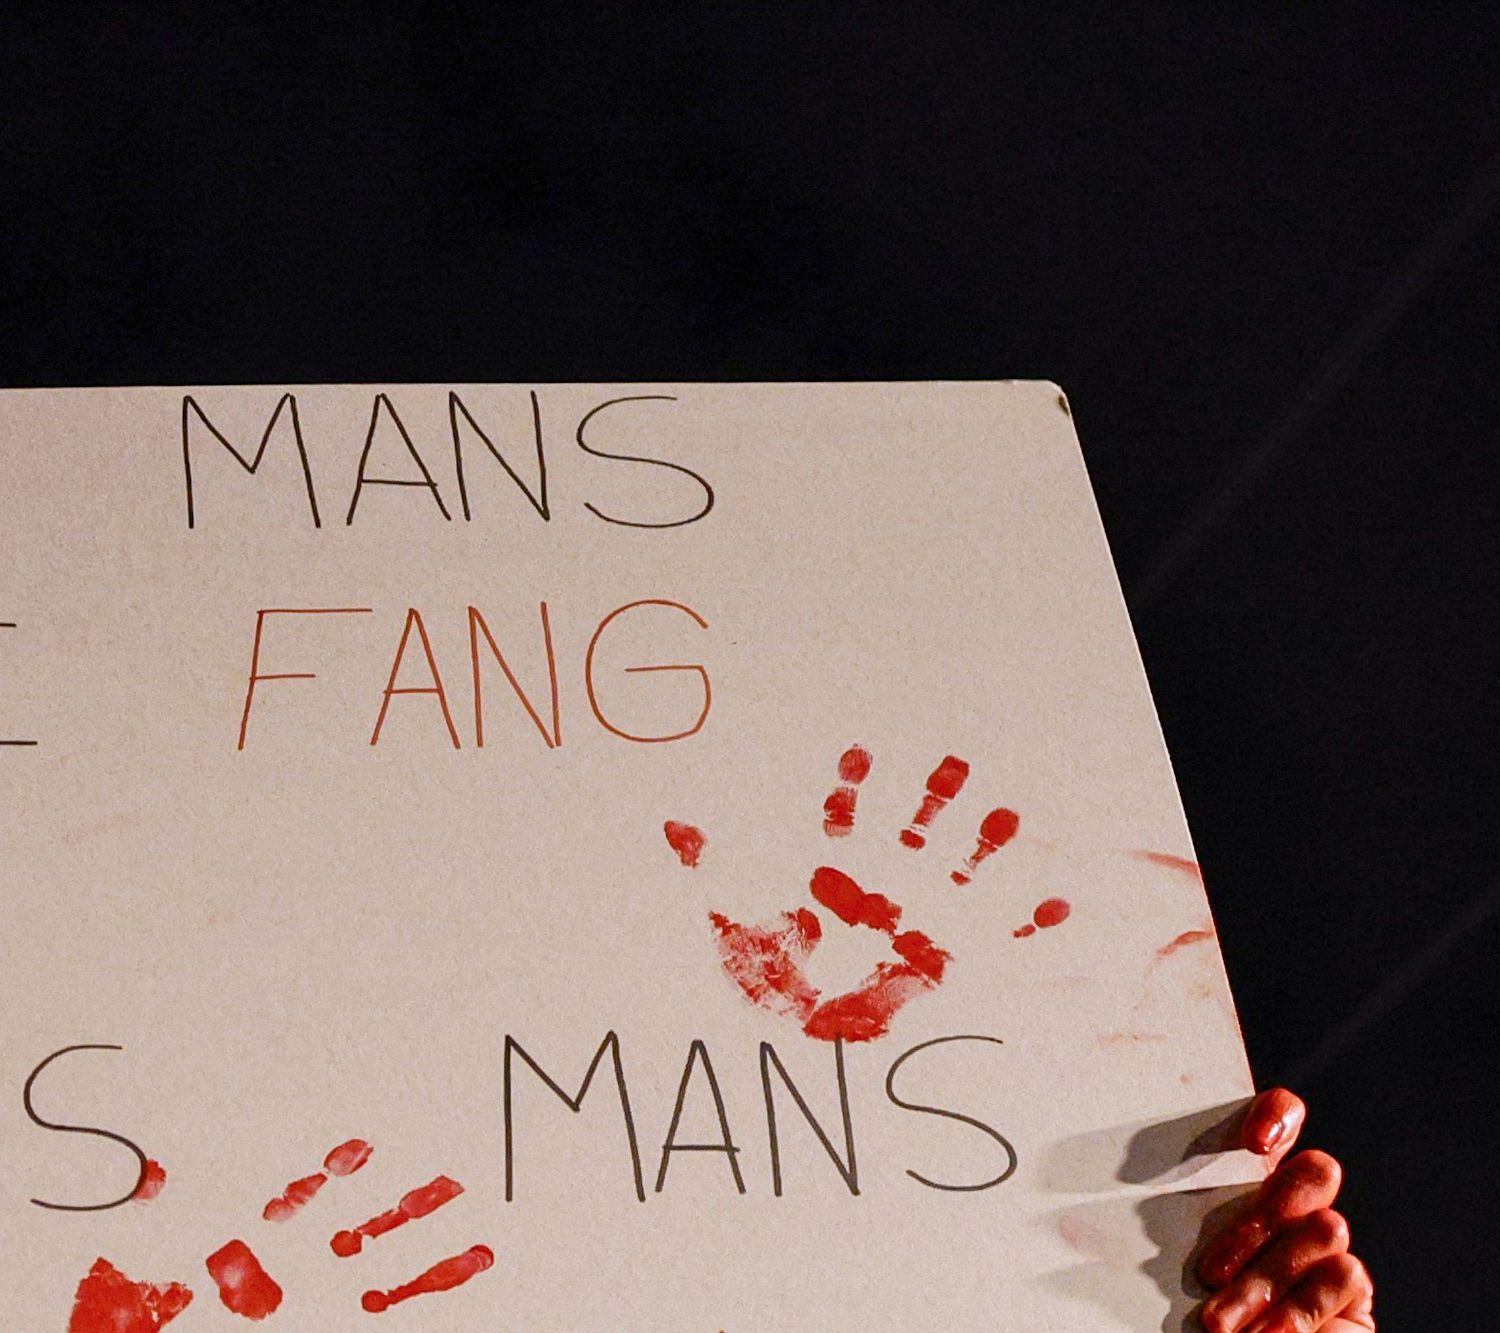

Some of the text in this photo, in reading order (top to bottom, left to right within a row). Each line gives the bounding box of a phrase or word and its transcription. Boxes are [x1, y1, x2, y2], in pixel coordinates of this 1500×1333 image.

[182, 391, 715, 528] MANS
[238, 599, 712, 749] FANG
[504, 1030, 1018, 1202] MANS
